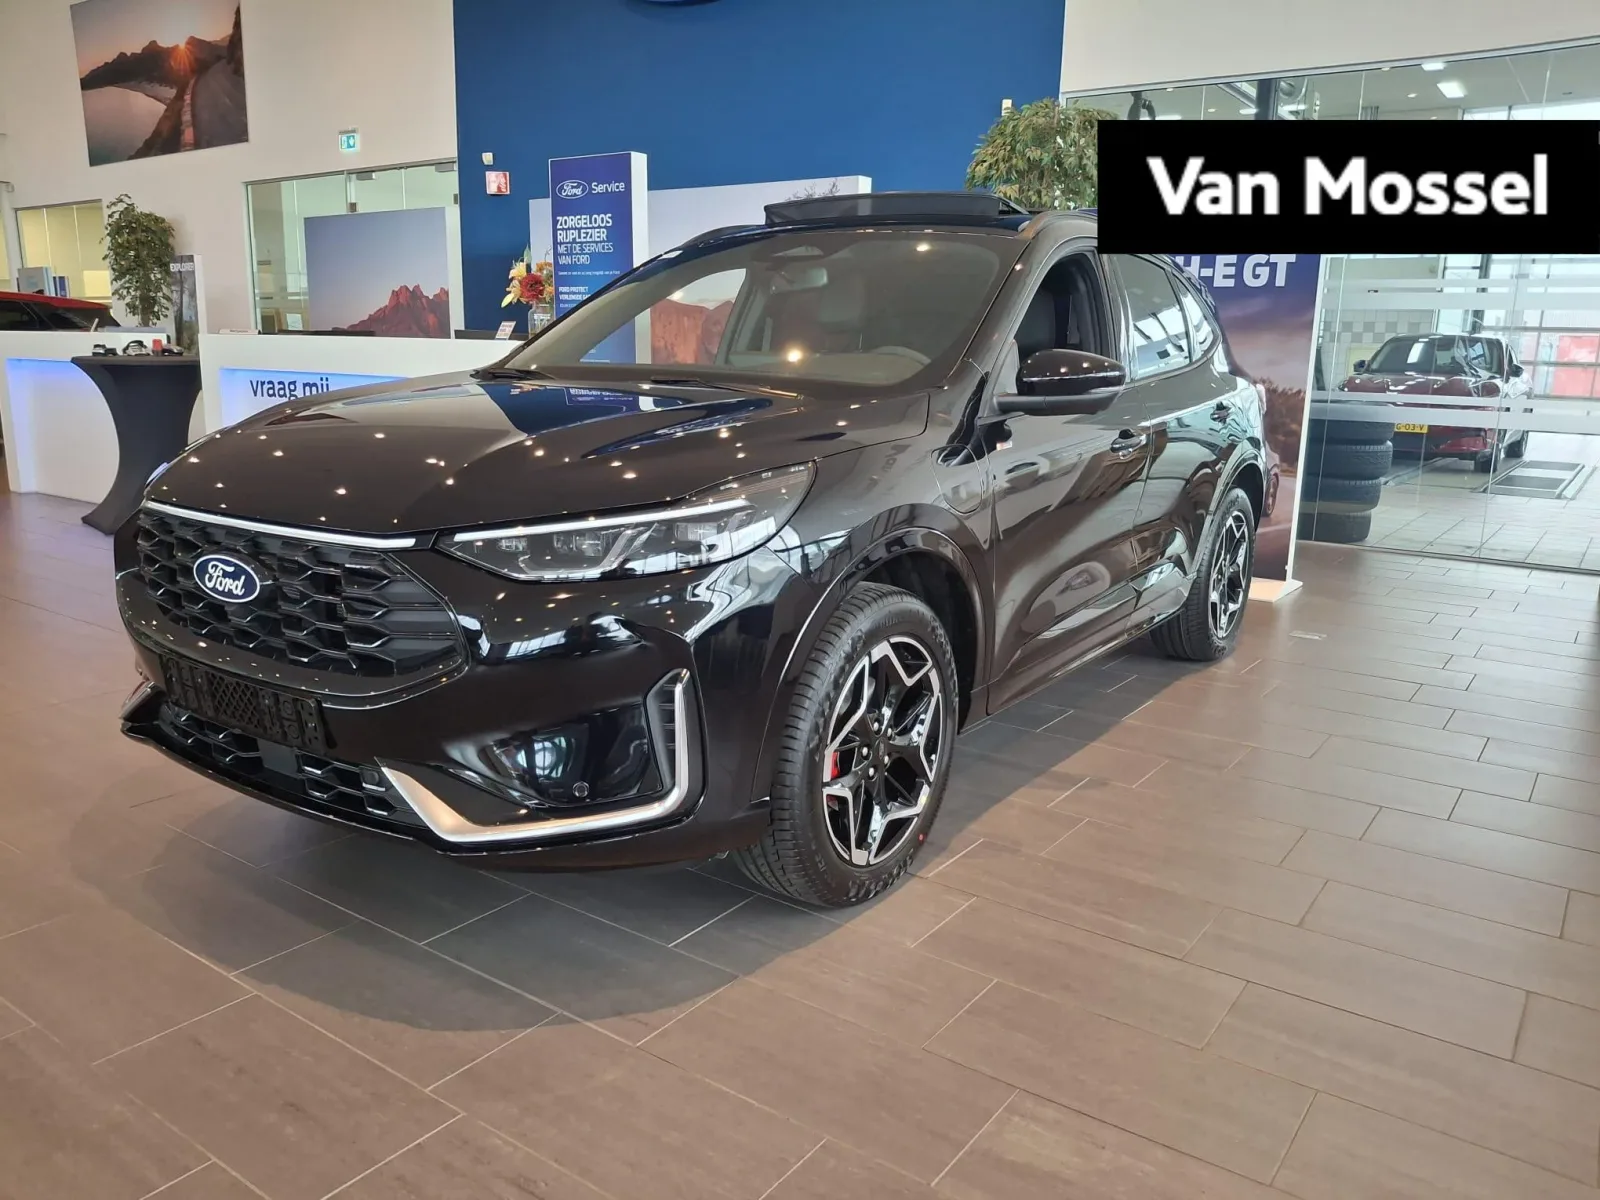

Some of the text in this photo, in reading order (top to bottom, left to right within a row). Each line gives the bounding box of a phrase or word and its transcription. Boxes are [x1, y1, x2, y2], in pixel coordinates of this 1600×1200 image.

[562, 181, 626, 196] Ford Service
[556, 213, 613, 229] ZORGELOOS
[557, 228, 607, 243] RIJPLEZIER
[558, 242, 614, 254] MET DE SERVICES
[558, 254, 591, 265] VAN FORD
[1243, 254, 1296, 287] GT
[249, 379, 298, 401] vraag
[204, 561, 246, 596] Ford
